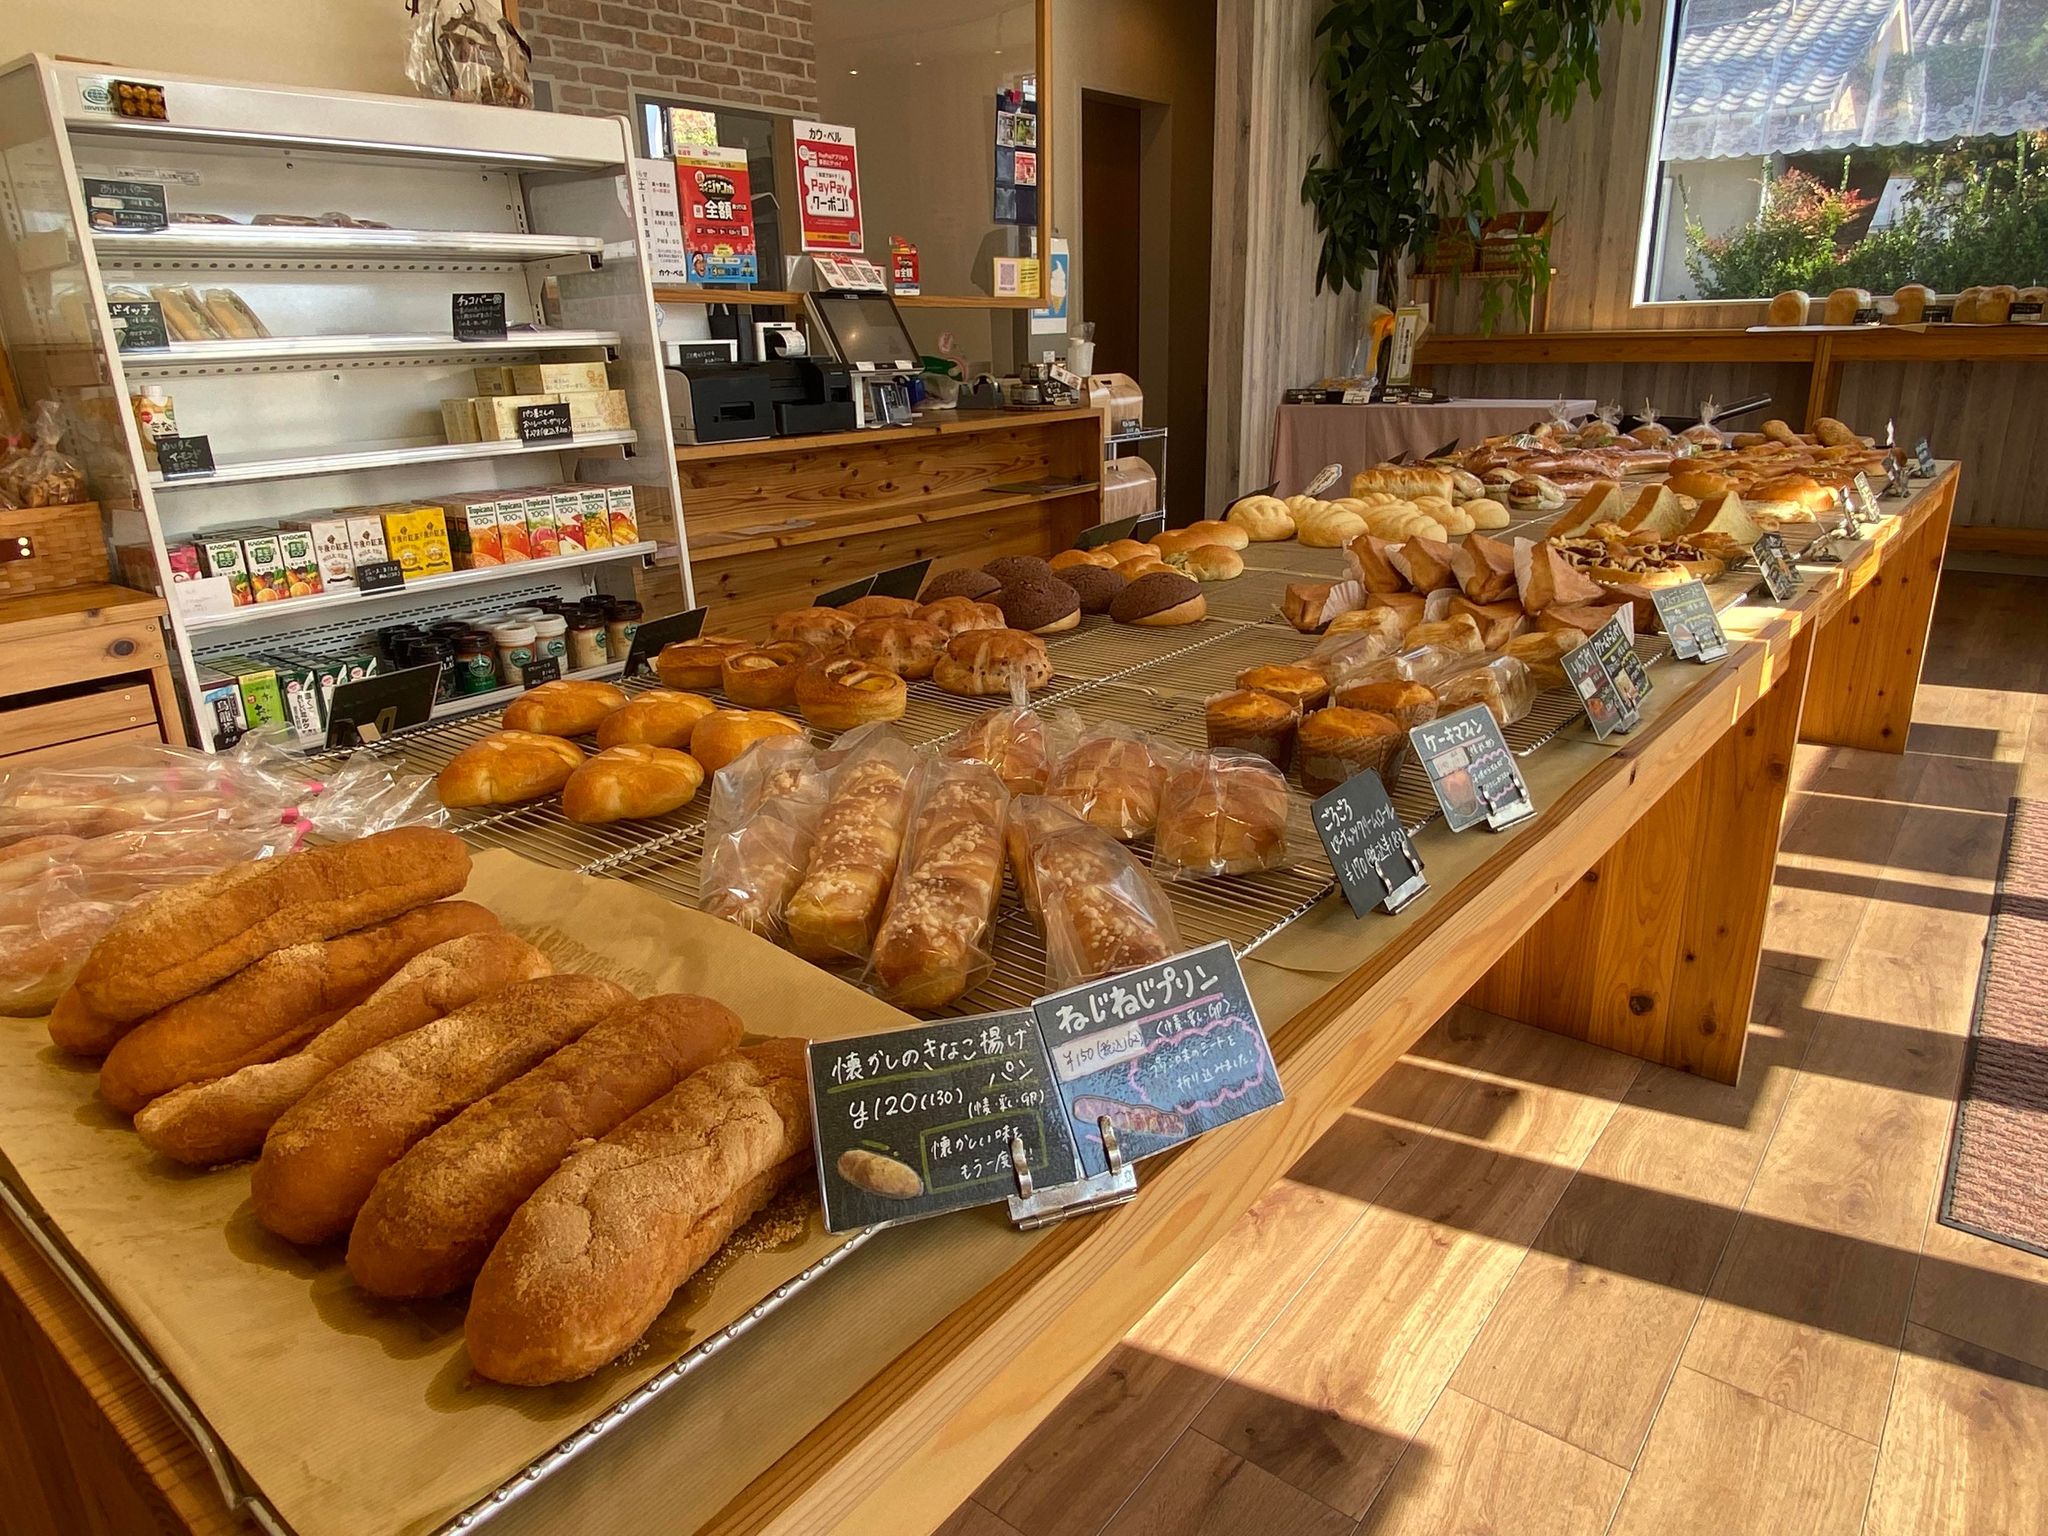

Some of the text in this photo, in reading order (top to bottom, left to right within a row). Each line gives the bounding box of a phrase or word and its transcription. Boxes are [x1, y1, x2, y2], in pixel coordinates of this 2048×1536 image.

[809, 127, 841, 143] カウ・ベル
[811, 178, 848, 197] PayPay
[704, 199, 733, 220] 全額
[813, 196, 849, 212] クーポン!
[580, 492, 604, 500] Tropicana
[609, 488, 631, 497] Tropicana
[526, 498, 550, 507] Tropicana
[554, 495, 578, 503] Tropicana
[468, 505, 494, 514] Tropicana
[497, 502, 522, 511] Tropicana
[248, 538, 275, 547] KAGOME
[281, 533, 308, 542] KAGOME
[209, 543, 237, 551] KAGOME
[317, 542, 349, 553] 午後の紅茶
[353, 538, 384, 549] 午後の紅茶
[1422, 718, 1483, 752] ケーキマフィン
[1321, 798, 1353, 831] ごろごろ
[1056, 965, 1218, 1034] ねじねじプリン
[832, 1018, 1035, 1085] 懐かしのきなこ揚げ
[988, 1059, 1034, 1089] パン
